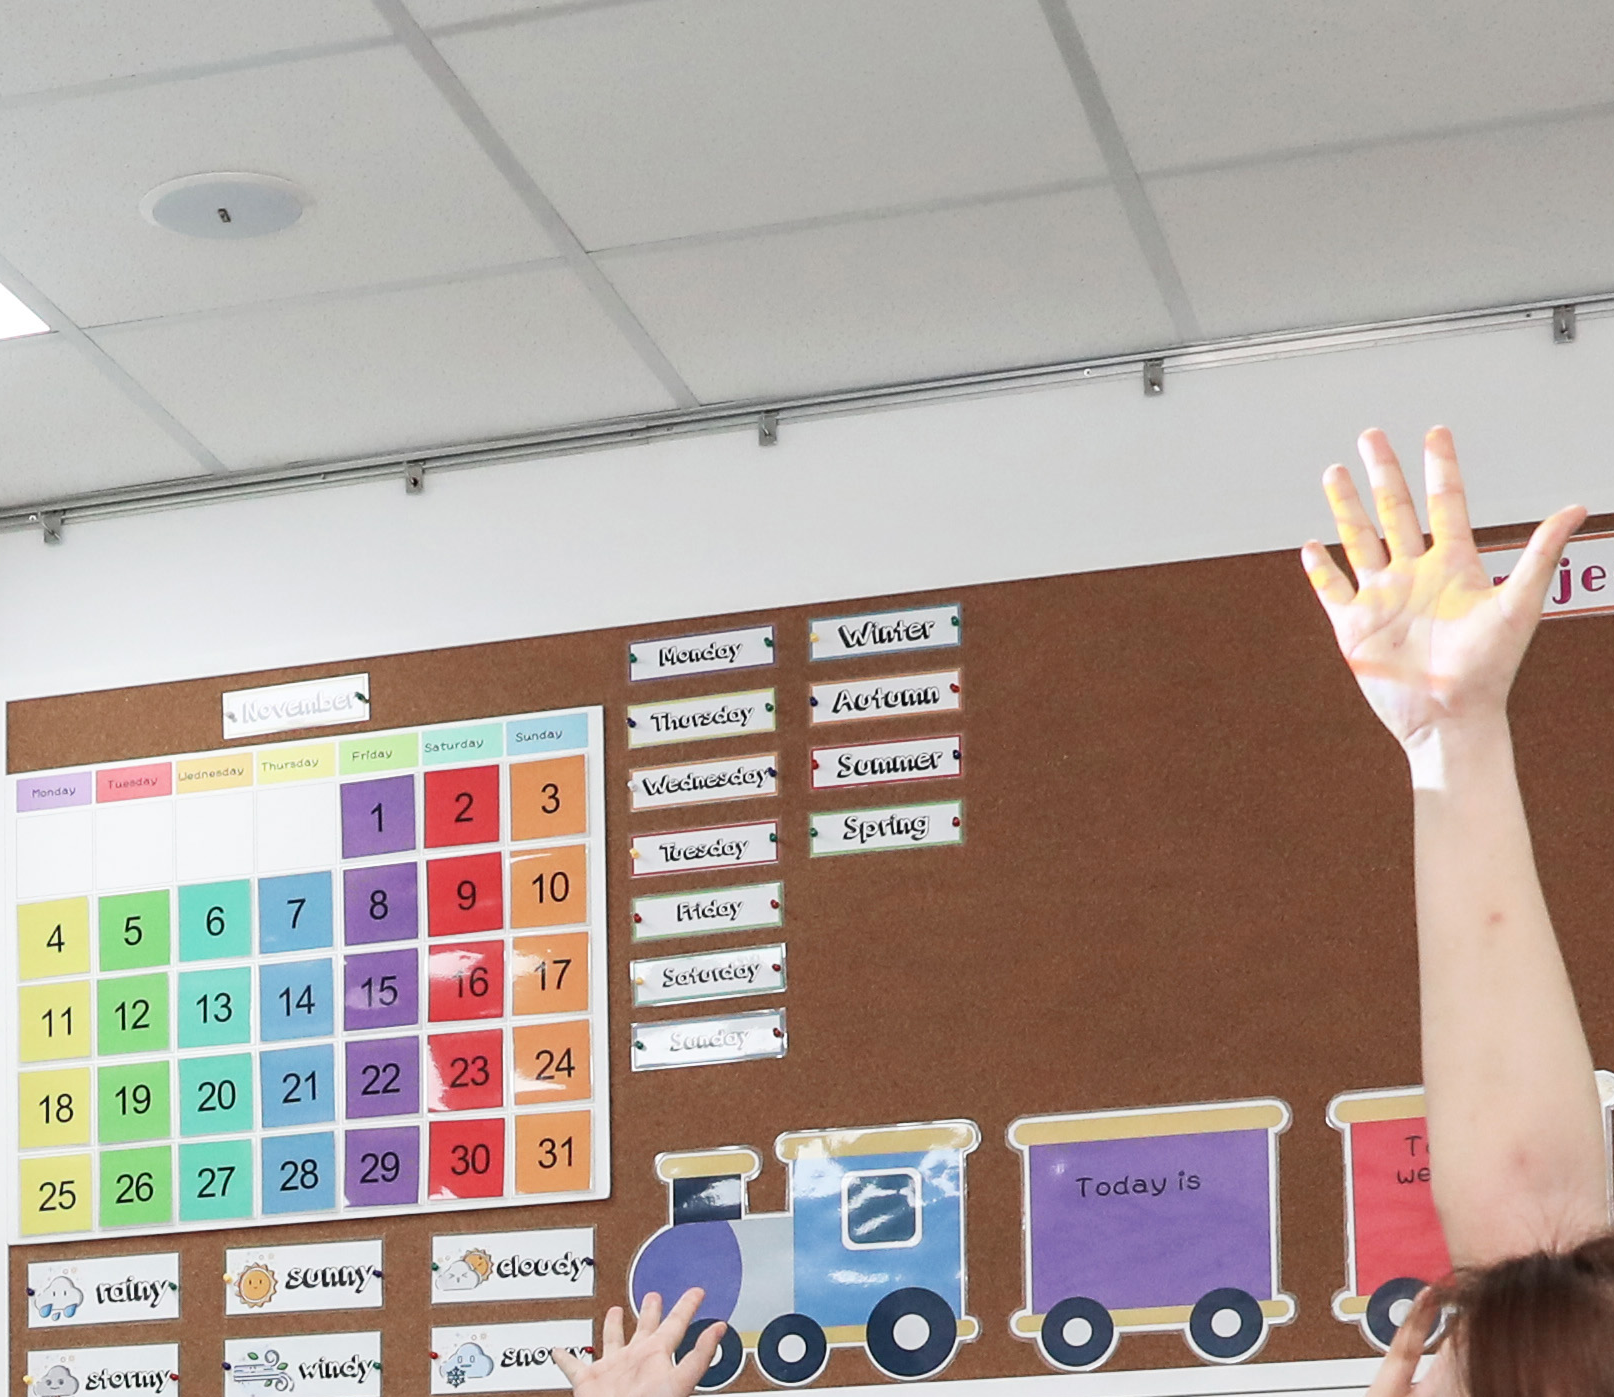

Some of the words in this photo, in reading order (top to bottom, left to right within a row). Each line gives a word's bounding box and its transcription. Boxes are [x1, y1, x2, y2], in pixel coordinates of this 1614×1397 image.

[839, 617, 935, 649] Winter
[659, 639, 742, 666] Monday
[831, 682, 940, 714] Autumn
[650, 702, 754, 732] Thursday
[32, 787, 76, 798] Monday
[108, 777, 158, 789] Tuesday
[262, 758, 319, 771] Thursday
[352, 749, 393, 761] Friday
[425, 739, 484, 752] Saturday
[515, 729, 562, 742] Sunday
[837, 749, 943, 779] Summer
[642, 765, 770, 796] Wednesday
[370, 803, 382, 832] 1
[456, 793, 472, 822] 2
[542, 784, 559, 813] 3
[842, 813, 930, 842] Spring
[659, 835, 748, 863] Tuesday
[47, 925, 64, 952] 4
[125, 917, 142, 945] 5
[207, 907, 224, 935] 6
[288, 899, 305, 928] 7
[370, 890, 388, 919] 8
[458, 881, 475, 909] 9
[533, 872, 568, 903] 10
[676, 899, 743, 922] Friday
[663, 960, 760, 988] Saturday
[43, 1008, 71, 1036] 11
[116, 1000, 149, 1030] 12
[197, 993, 231, 1023] 13
[280, 986, 314, 1016] 14
[362, 976, 397, 1005] 15
[460, 968, 488, 996] 16
[537, 960, 570, 990] 17
[669, 1028, 749, 1052] Sunday
[40, 1094, 73, 1123] 18
[116, 1085, 150, 1114] 19
[199, 1080, 235, 1111] 20
[283, 1072, 315, 1103] 21
[362, 1064, 400, 1095] 22
[451, 1056, 489, 1087] 23
[537, 1049, 574, 1079] 24
[40, 1181, 75, 1211] 25
[117, 1173, 153, 1203] 26
[198, 1167, 235, 1197] 27
[281, 1159, 318, 1191] 28
[361, 1152, 399, 1183] 29
[452, 1144, 489, 1175] 30
[539, 1137, 571, 1168] 31
[1076, 1173, 1168, 1200] Today
[1178, 1170, 1202, 1192] is
[284, 1261, 374, 1293] sunny
[496, 1245, 589, 1280] cloudy
[95, 1275, 171, 1307] rainy
[85, 1364, 171, 1393] stormy
[298, 1354, 374, 1382] windy
